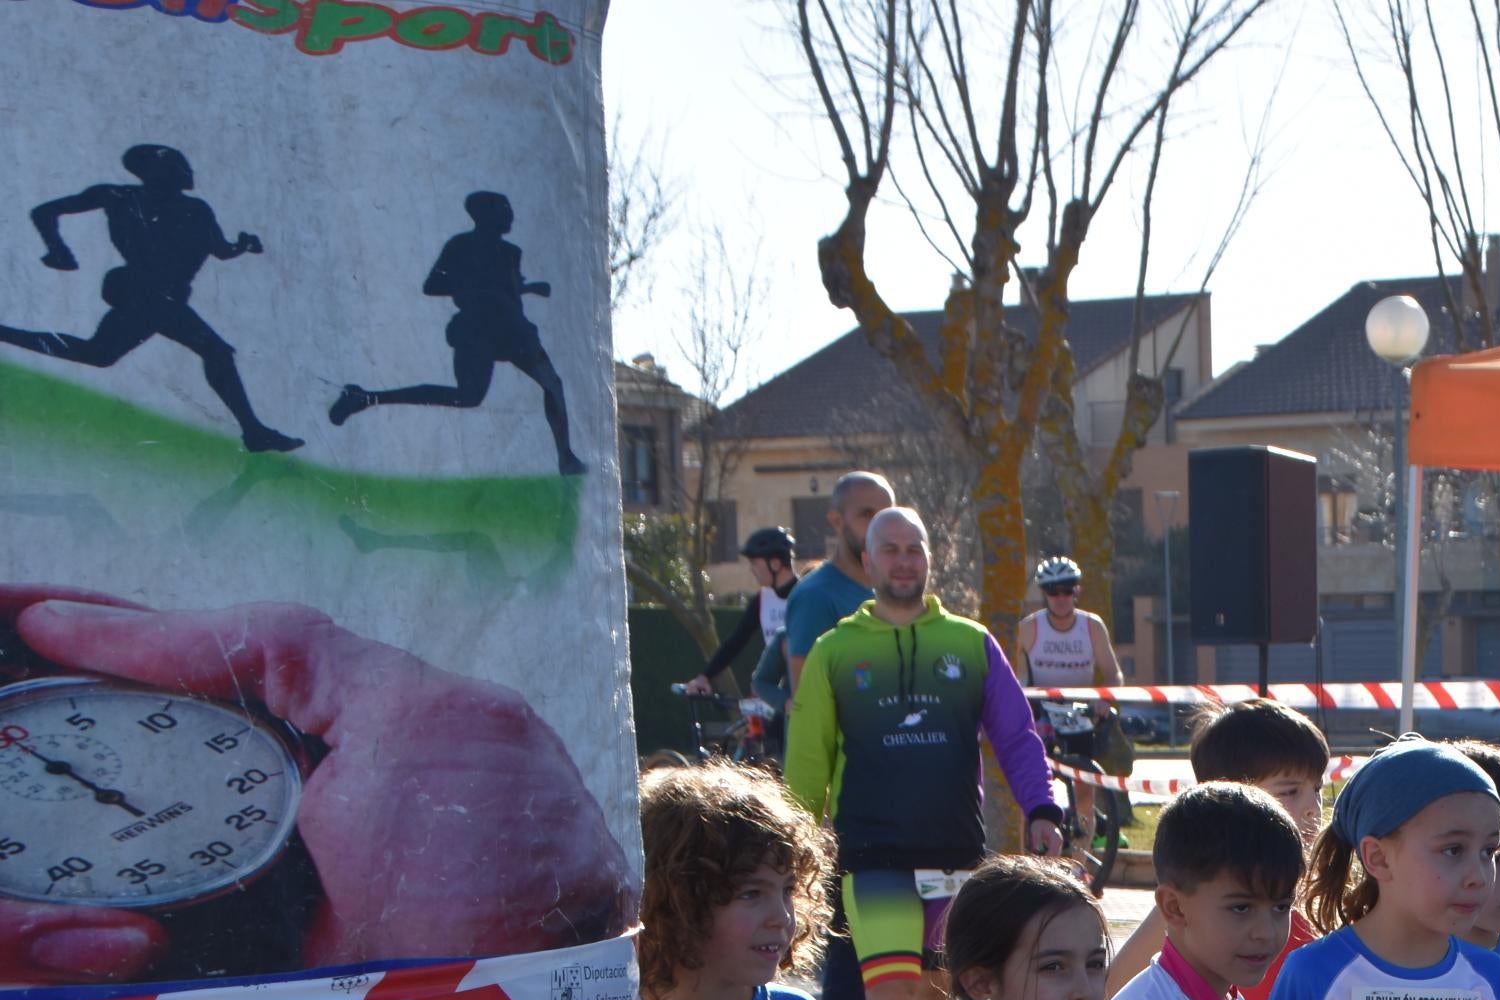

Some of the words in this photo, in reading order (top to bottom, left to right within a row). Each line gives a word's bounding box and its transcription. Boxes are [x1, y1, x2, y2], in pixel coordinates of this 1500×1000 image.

[66, 713, 96, 731] 5
[138, 711, 178, 733] 10
[204, 733, 240, 754] 15
[882, 732, 948, 746] CHEVALIER
[227, 768, 269, 795] 20
[110, 801, 194, 843] HERWINS
[225, 805, 267, 831] 25
[190, 840, 234, 867] 30
[47, 856, 93, 882] 40
[117, 858, 166, 885] 35
